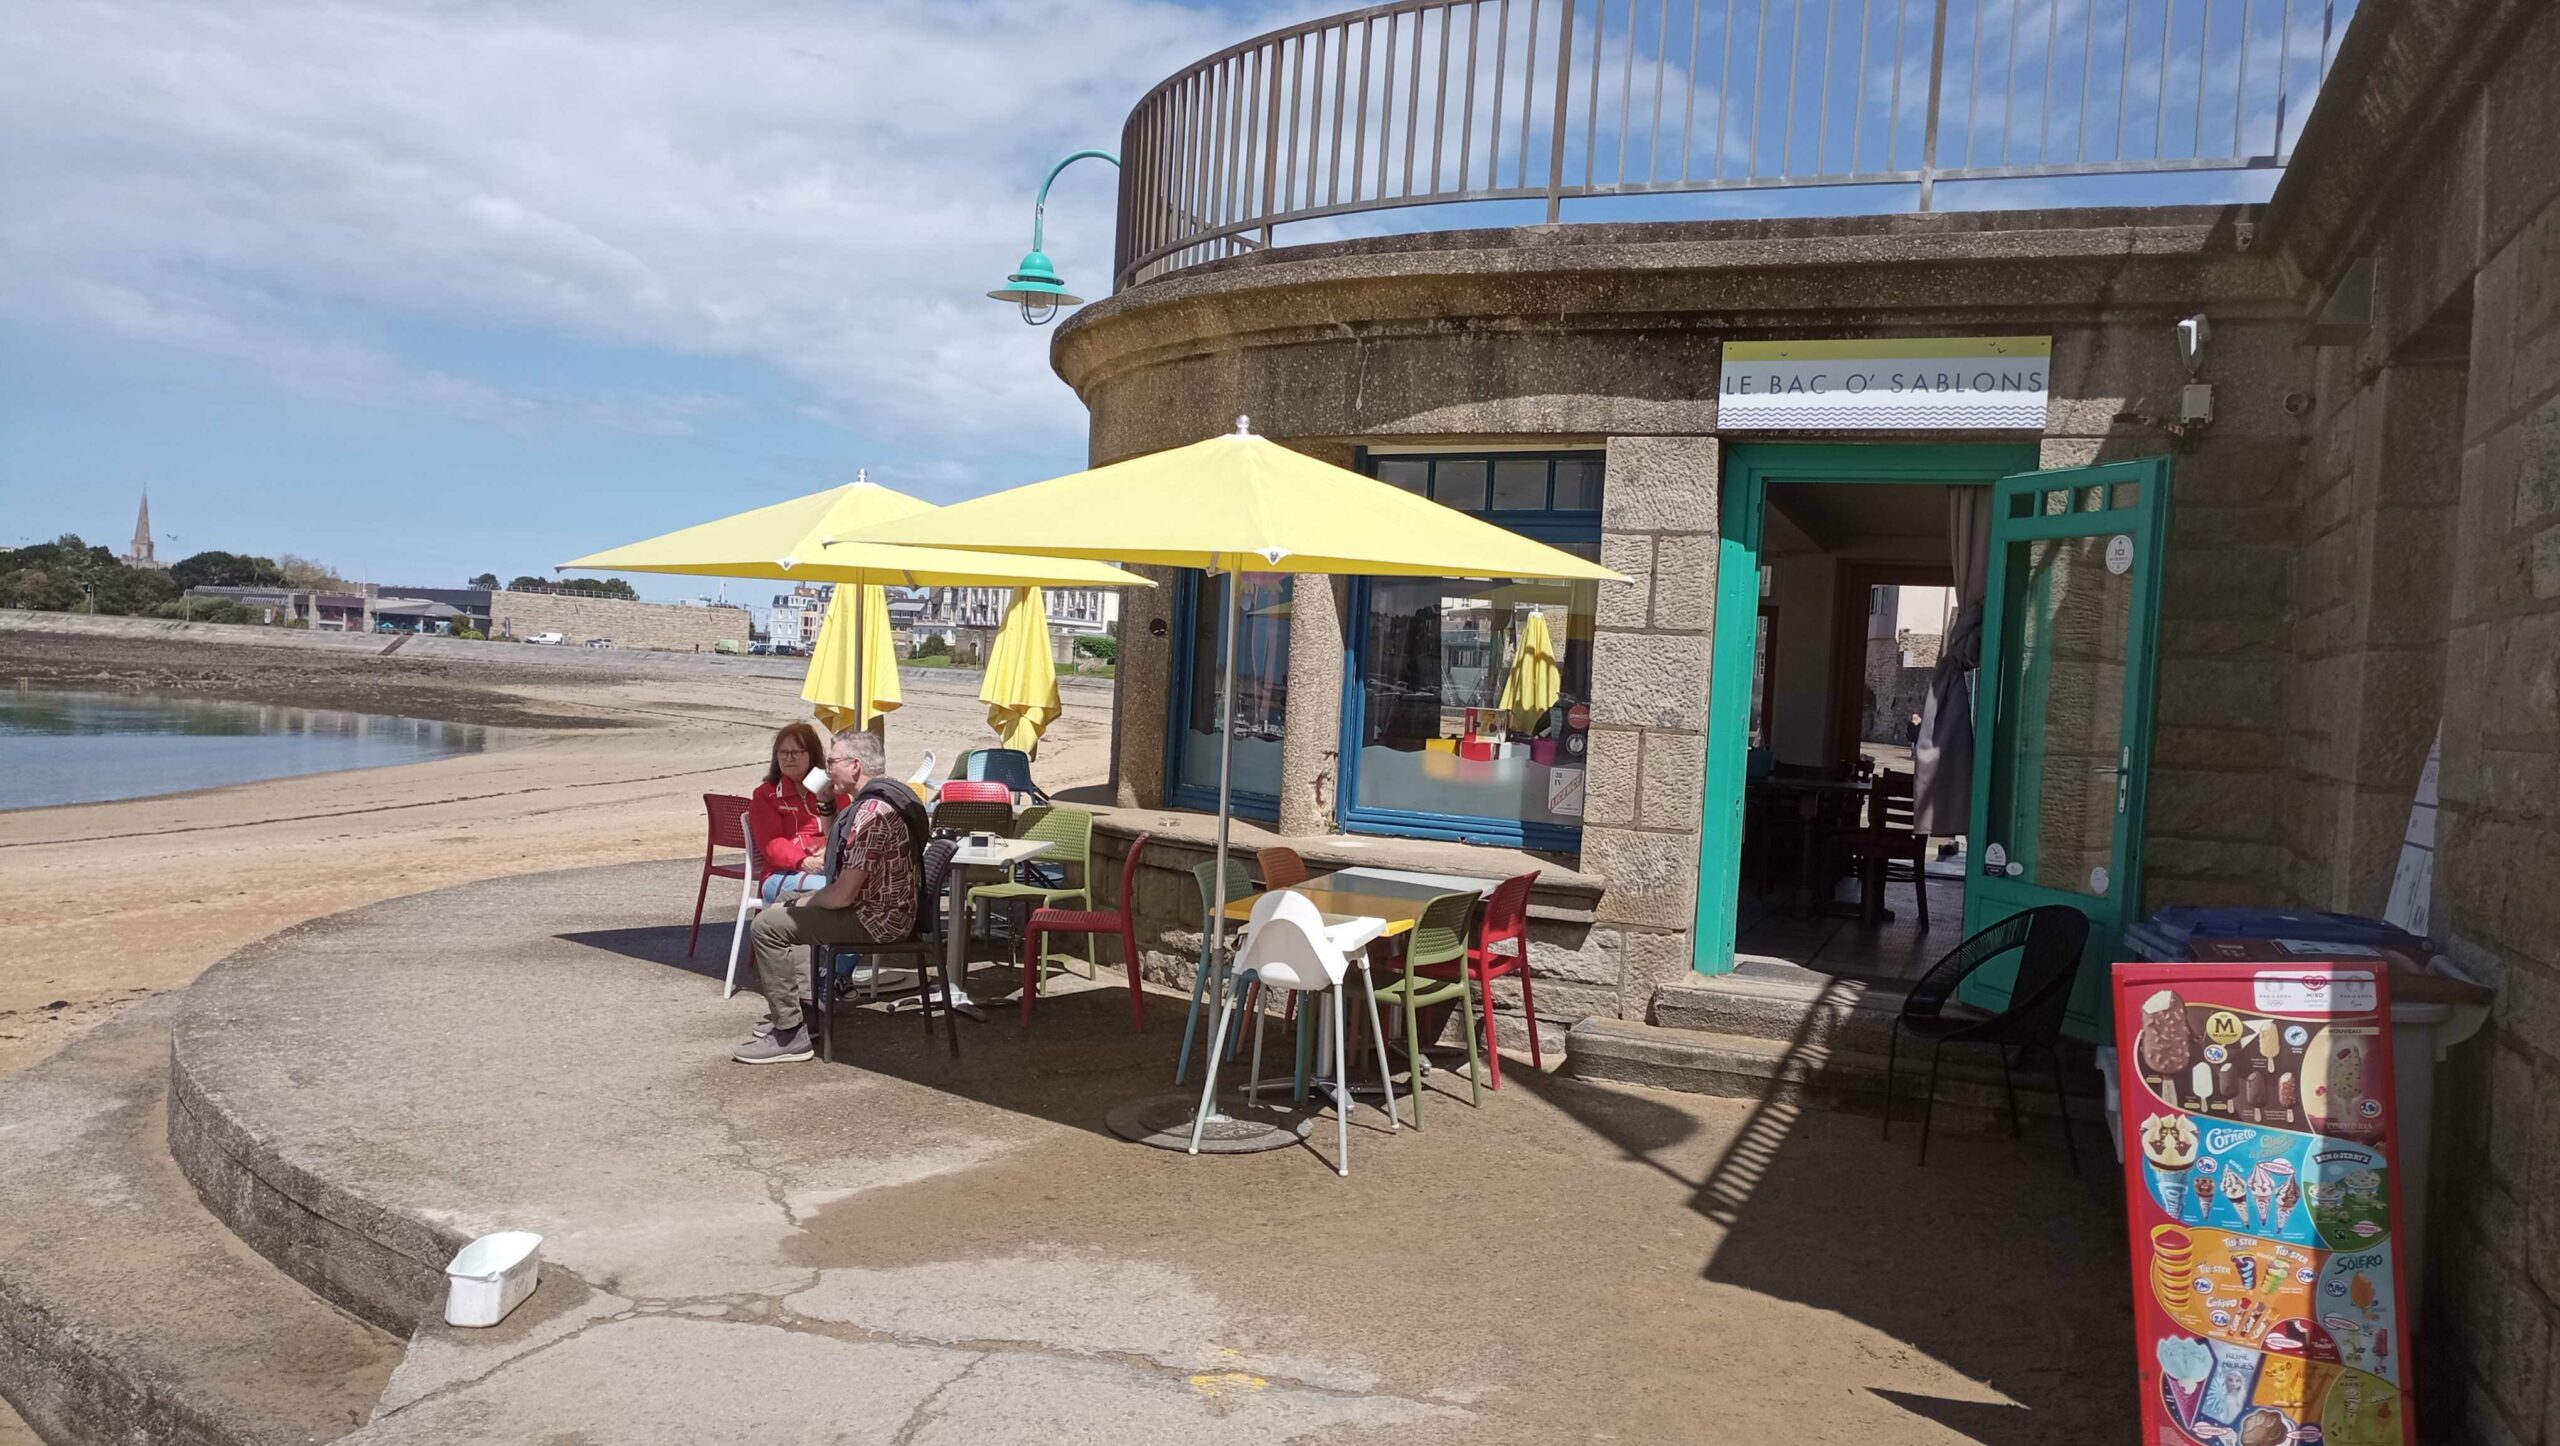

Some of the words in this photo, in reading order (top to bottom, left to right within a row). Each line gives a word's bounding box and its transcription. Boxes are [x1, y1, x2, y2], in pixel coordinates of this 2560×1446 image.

[1726, 375, 1752, 395] LE
[1769, 374, 1827, 395] BAC
[1890, 372, 2042, 394] SABLONS
[2214, 1017, 2235, 1034] M
[2206, 1127, 2257, 1155] Cornetto
[2334, 1254, 2383, 1275] SOLERO
